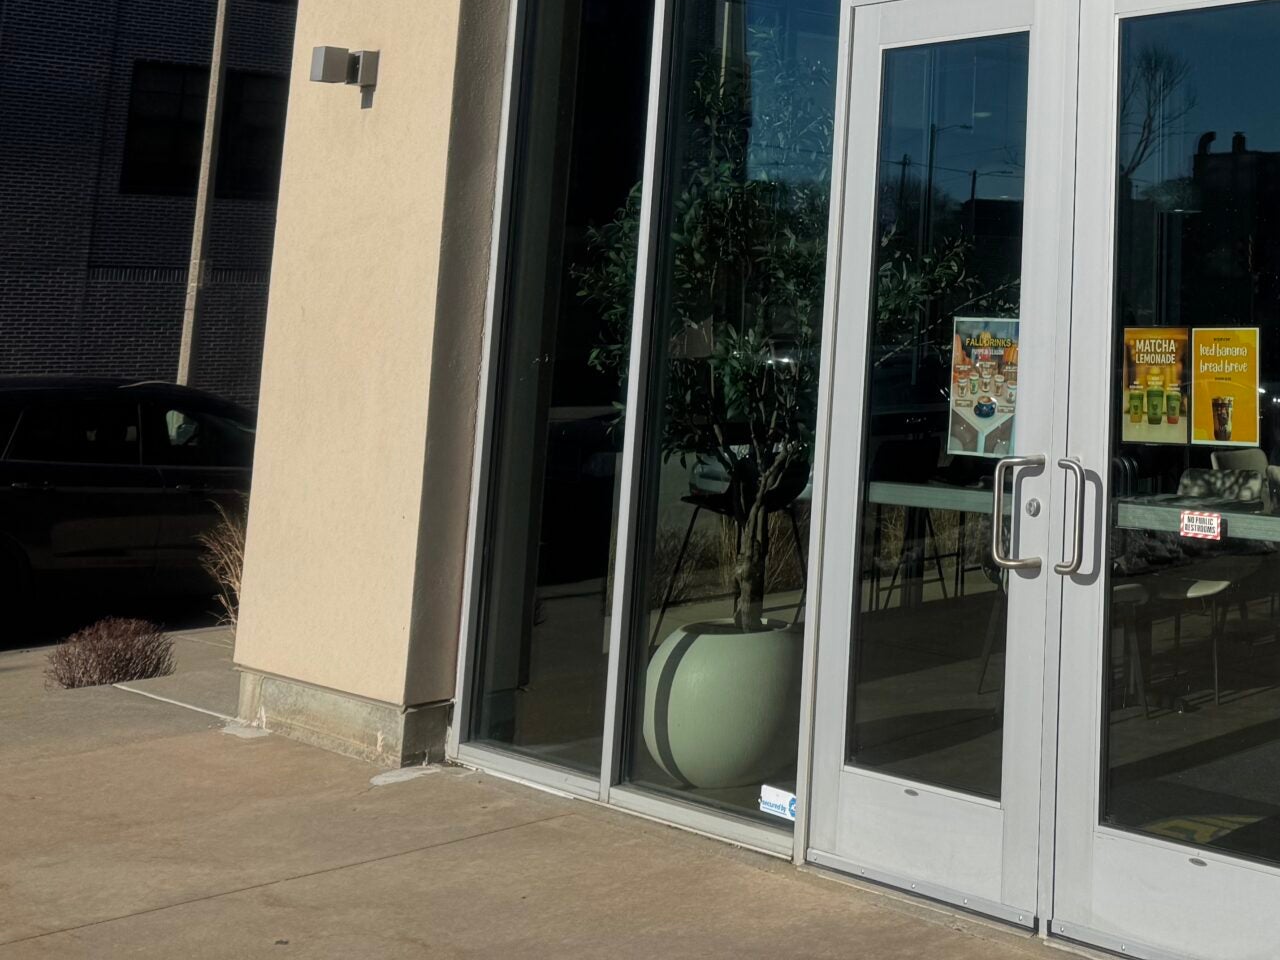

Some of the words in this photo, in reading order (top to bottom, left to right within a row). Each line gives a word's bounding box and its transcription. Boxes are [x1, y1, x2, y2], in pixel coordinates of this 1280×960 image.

[965, 337, 983, 347] FALL
[985, 338, 1012, 347] DRINKS
[1135, 339, 1176, 353] MATCHA
[1216, 343, 1248, 357] banana
[1135, 353, 1176, 364] LEMONADE
[1200, 359, 1223, 373] bread
[1187, 516, 1195, 524] NO
